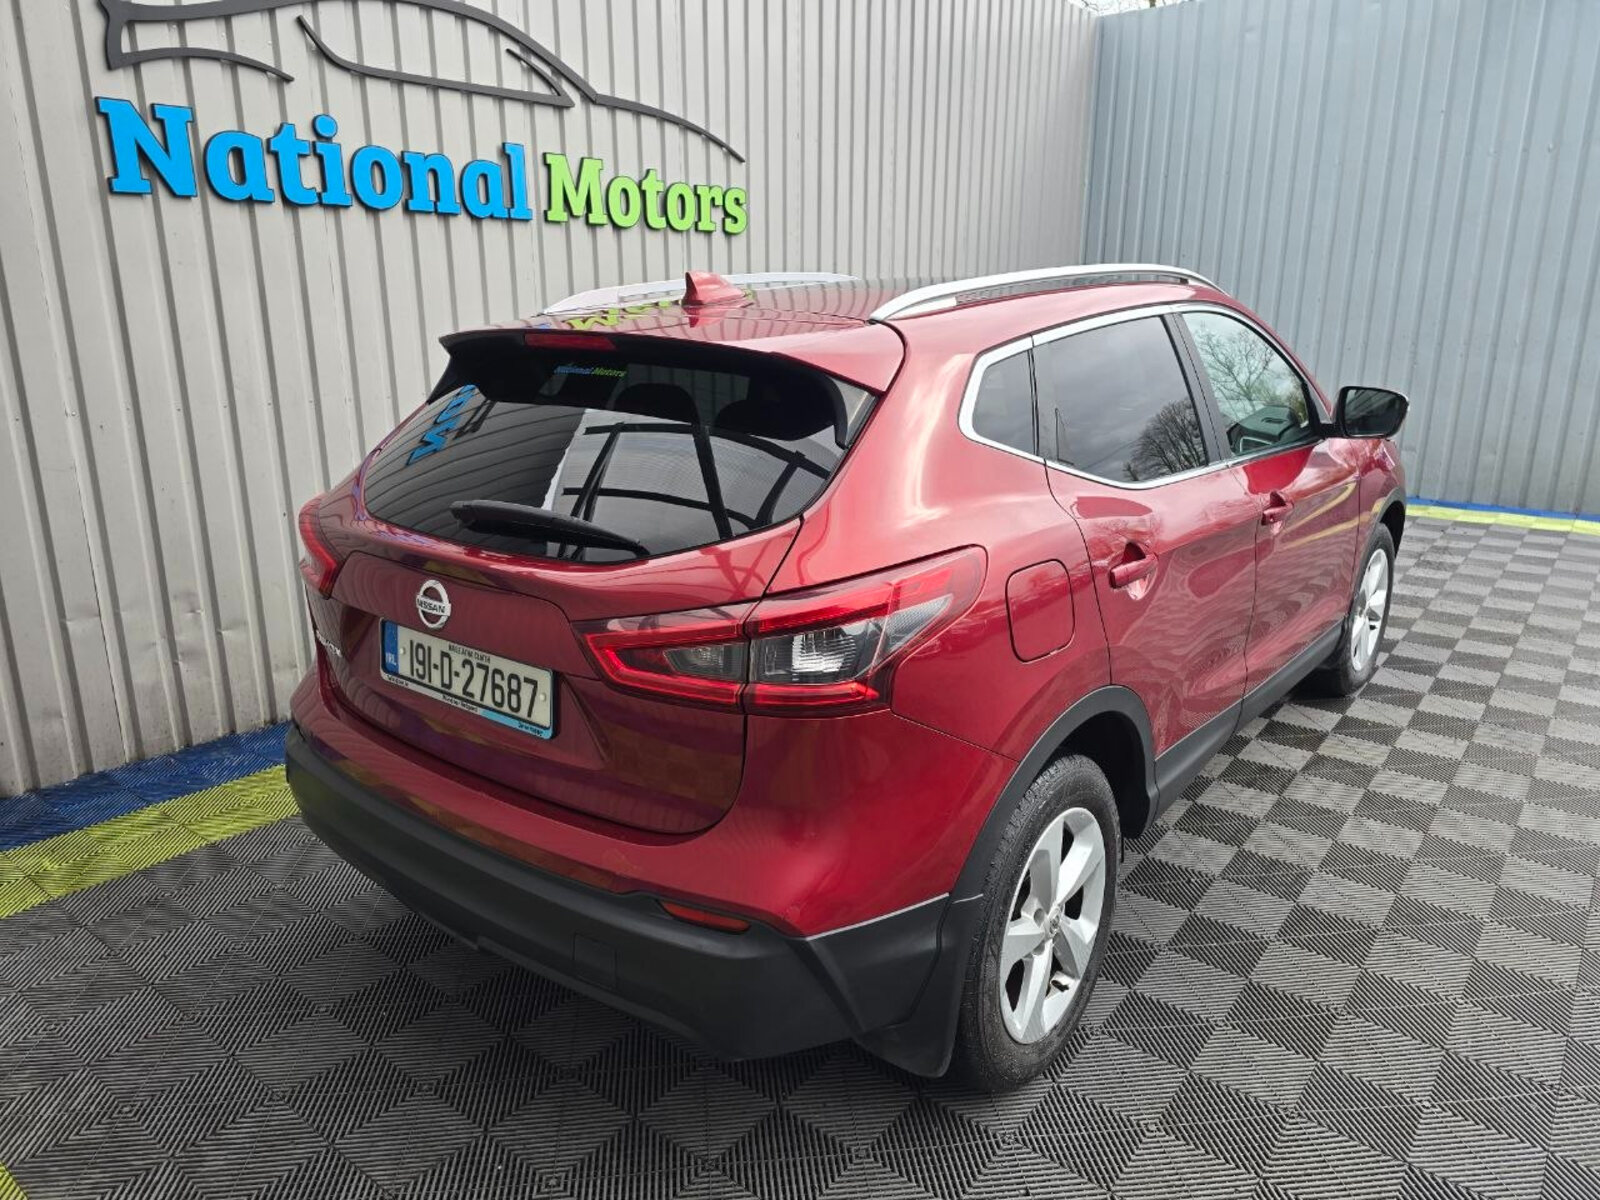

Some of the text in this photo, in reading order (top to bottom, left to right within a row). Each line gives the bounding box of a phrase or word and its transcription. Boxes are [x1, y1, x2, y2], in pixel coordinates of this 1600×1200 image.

[95, 96, 747, 234] National Motors
[417, 598, 446, 613] NISSAN
[409, 639, 539, 719] 191-D-27687
